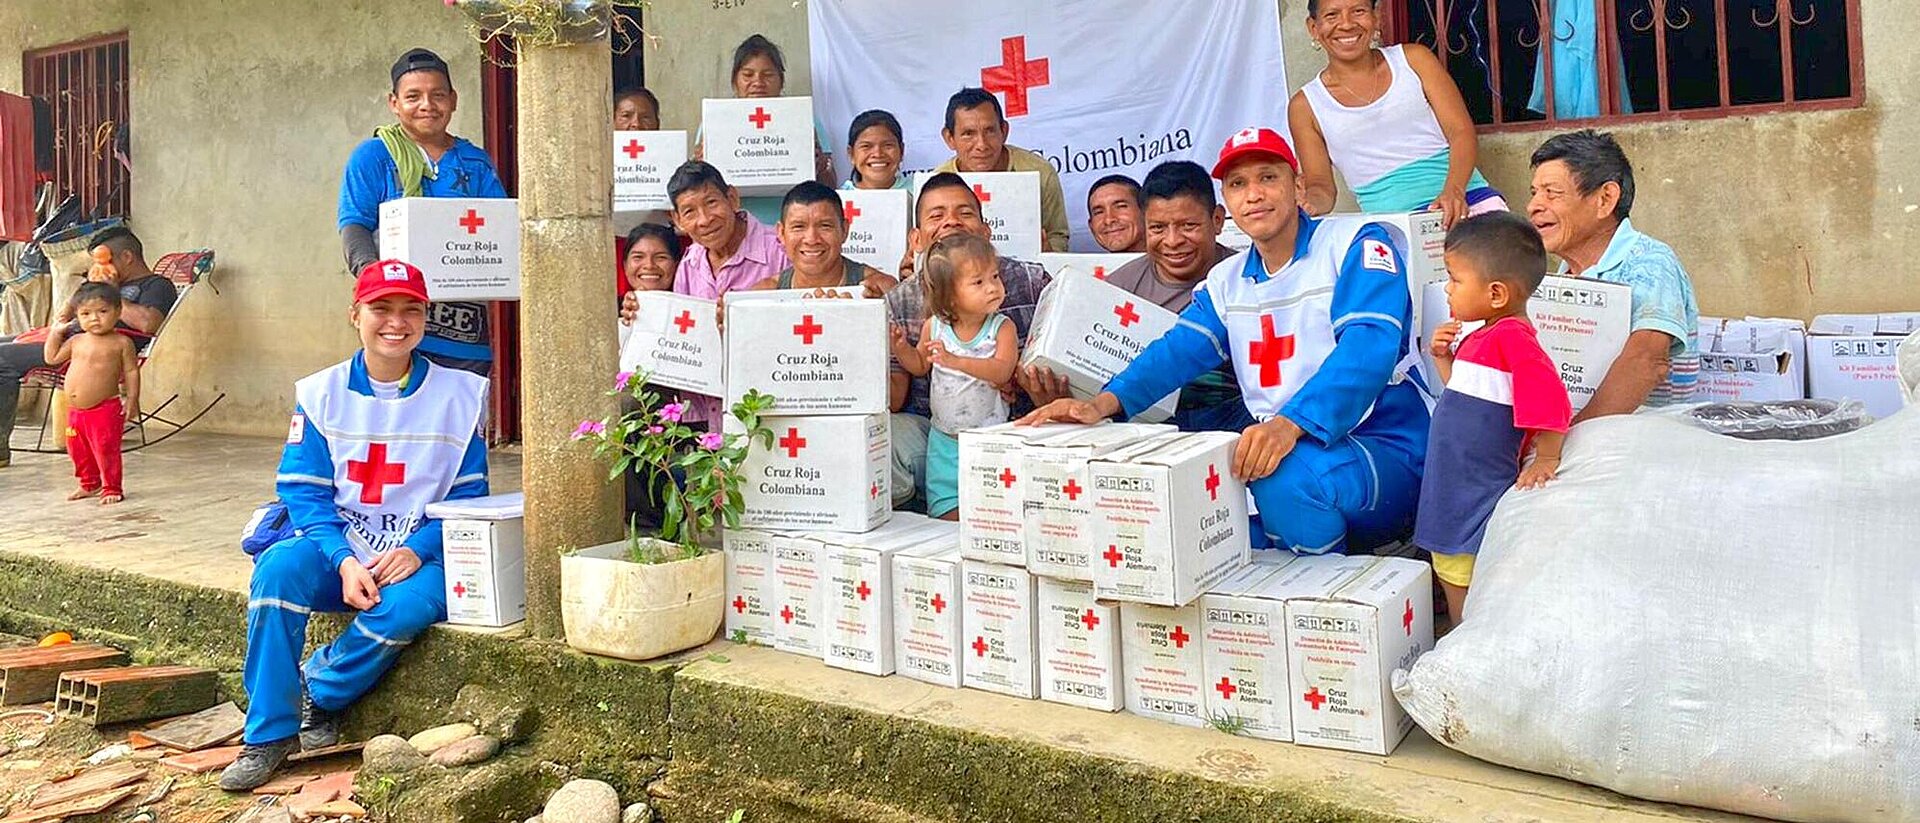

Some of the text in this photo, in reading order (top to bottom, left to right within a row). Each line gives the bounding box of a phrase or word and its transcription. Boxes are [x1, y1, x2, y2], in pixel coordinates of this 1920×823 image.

[737, 135, 786, 146] Cruz Roja
[734, 148, 790, 159] Colombiana
[616, 164, 656, 175] ruz Roja
[614, 174, 660, 184] olombiana
[850, 231, 873, 243] Roja
[446, 241, 498, 253] Cruz Roja
[441, 255, 502, 265] Colombiana
[1093, 322, 1119, 342] Cruz
[658, 338, 702, 355] Cruz Roja
[652, 350, 703, 368] Colombiana
[777, 353, 839, 367] Cruz Roja
[1561, 362, 1584, 373] Cruz
[771, 371, 845, 382] Colombiana
[1561, 372, 1583, 384] Roja
[764, 466, 821, 481] Cruz Roja
[760, 483, 825, 496] Colombiana
[1200, 506, 1230, 531] Cruz Roja
[1199, 527, 1234, 552] Colombiana
[1238, 679, 1257, 688] Cruz
[1239, 687, 1257, 696] Roja
[1328, 688, 1348, 698] Cruz
[1239, 695, 1273, 705] Alemana
[1329, 697, 1348, 706] Roja
[1329, 705, 1365, 716] Alemana
